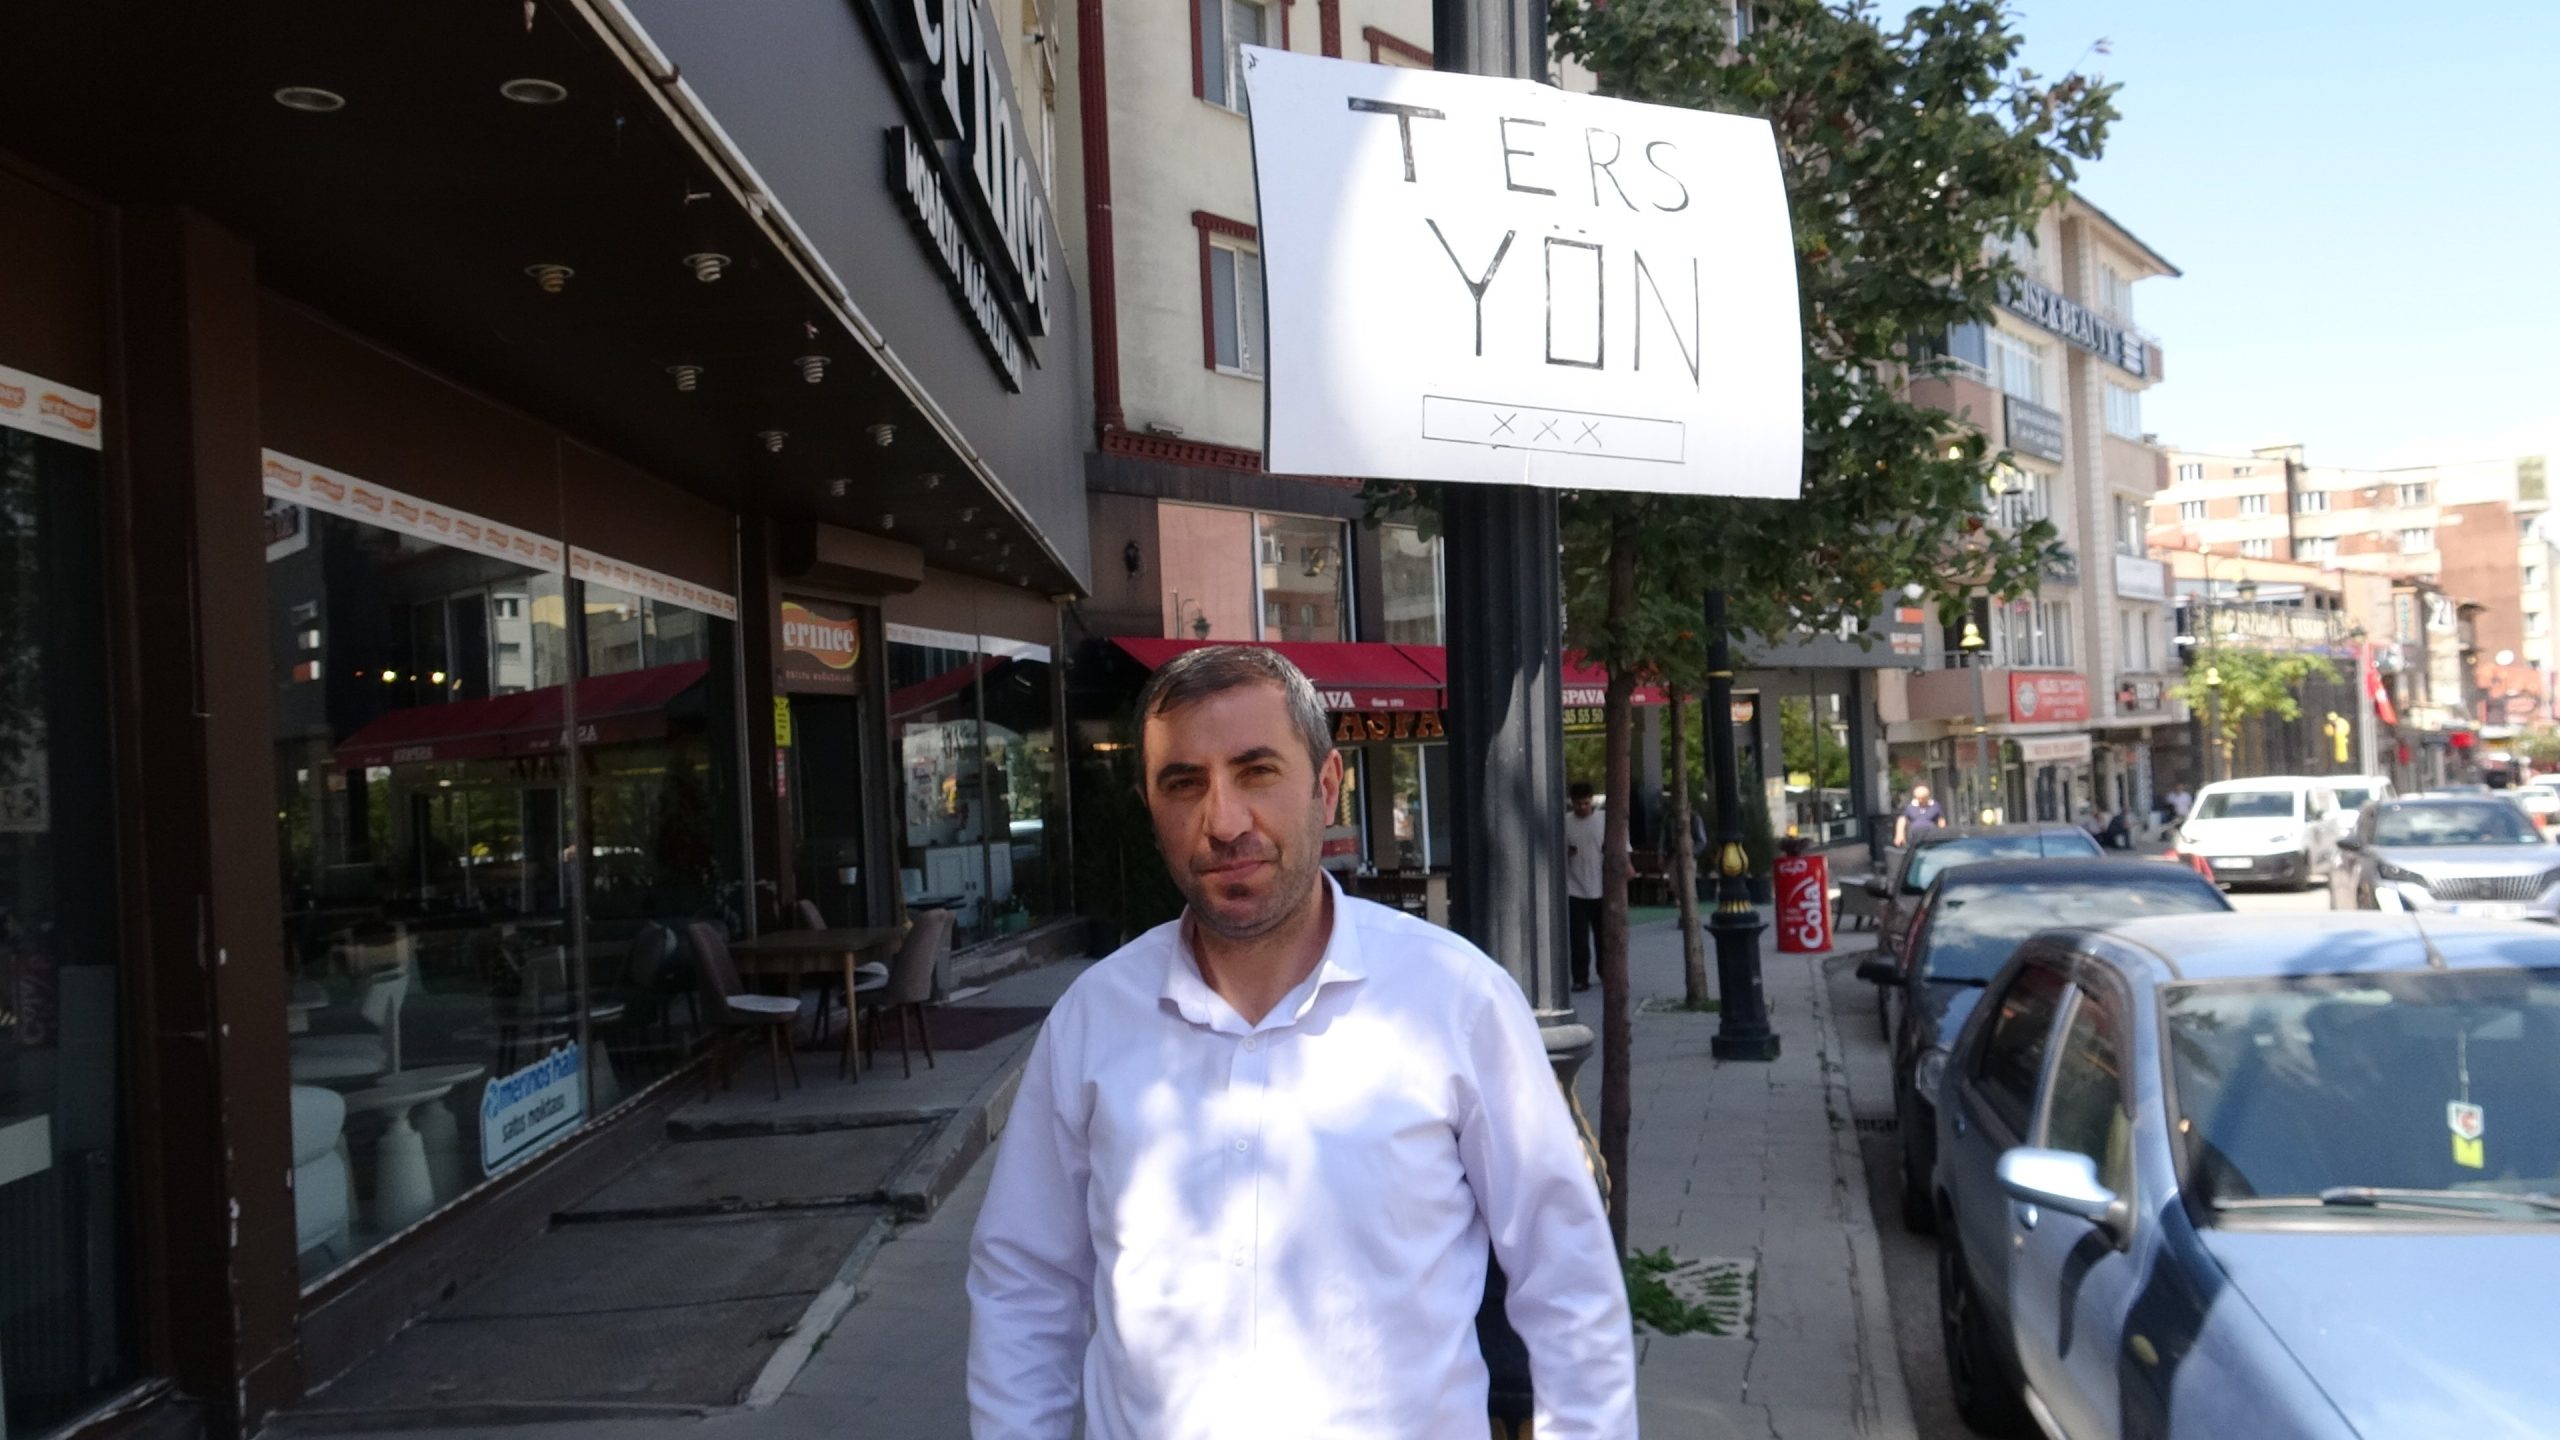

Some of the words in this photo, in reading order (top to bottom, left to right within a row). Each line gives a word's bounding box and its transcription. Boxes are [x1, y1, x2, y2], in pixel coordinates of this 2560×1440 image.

[1347, 97, 1690, 212] TERS
[1425, 217, 1700, 393] YÖN
[1799, 880, 1824, 949] Cola
